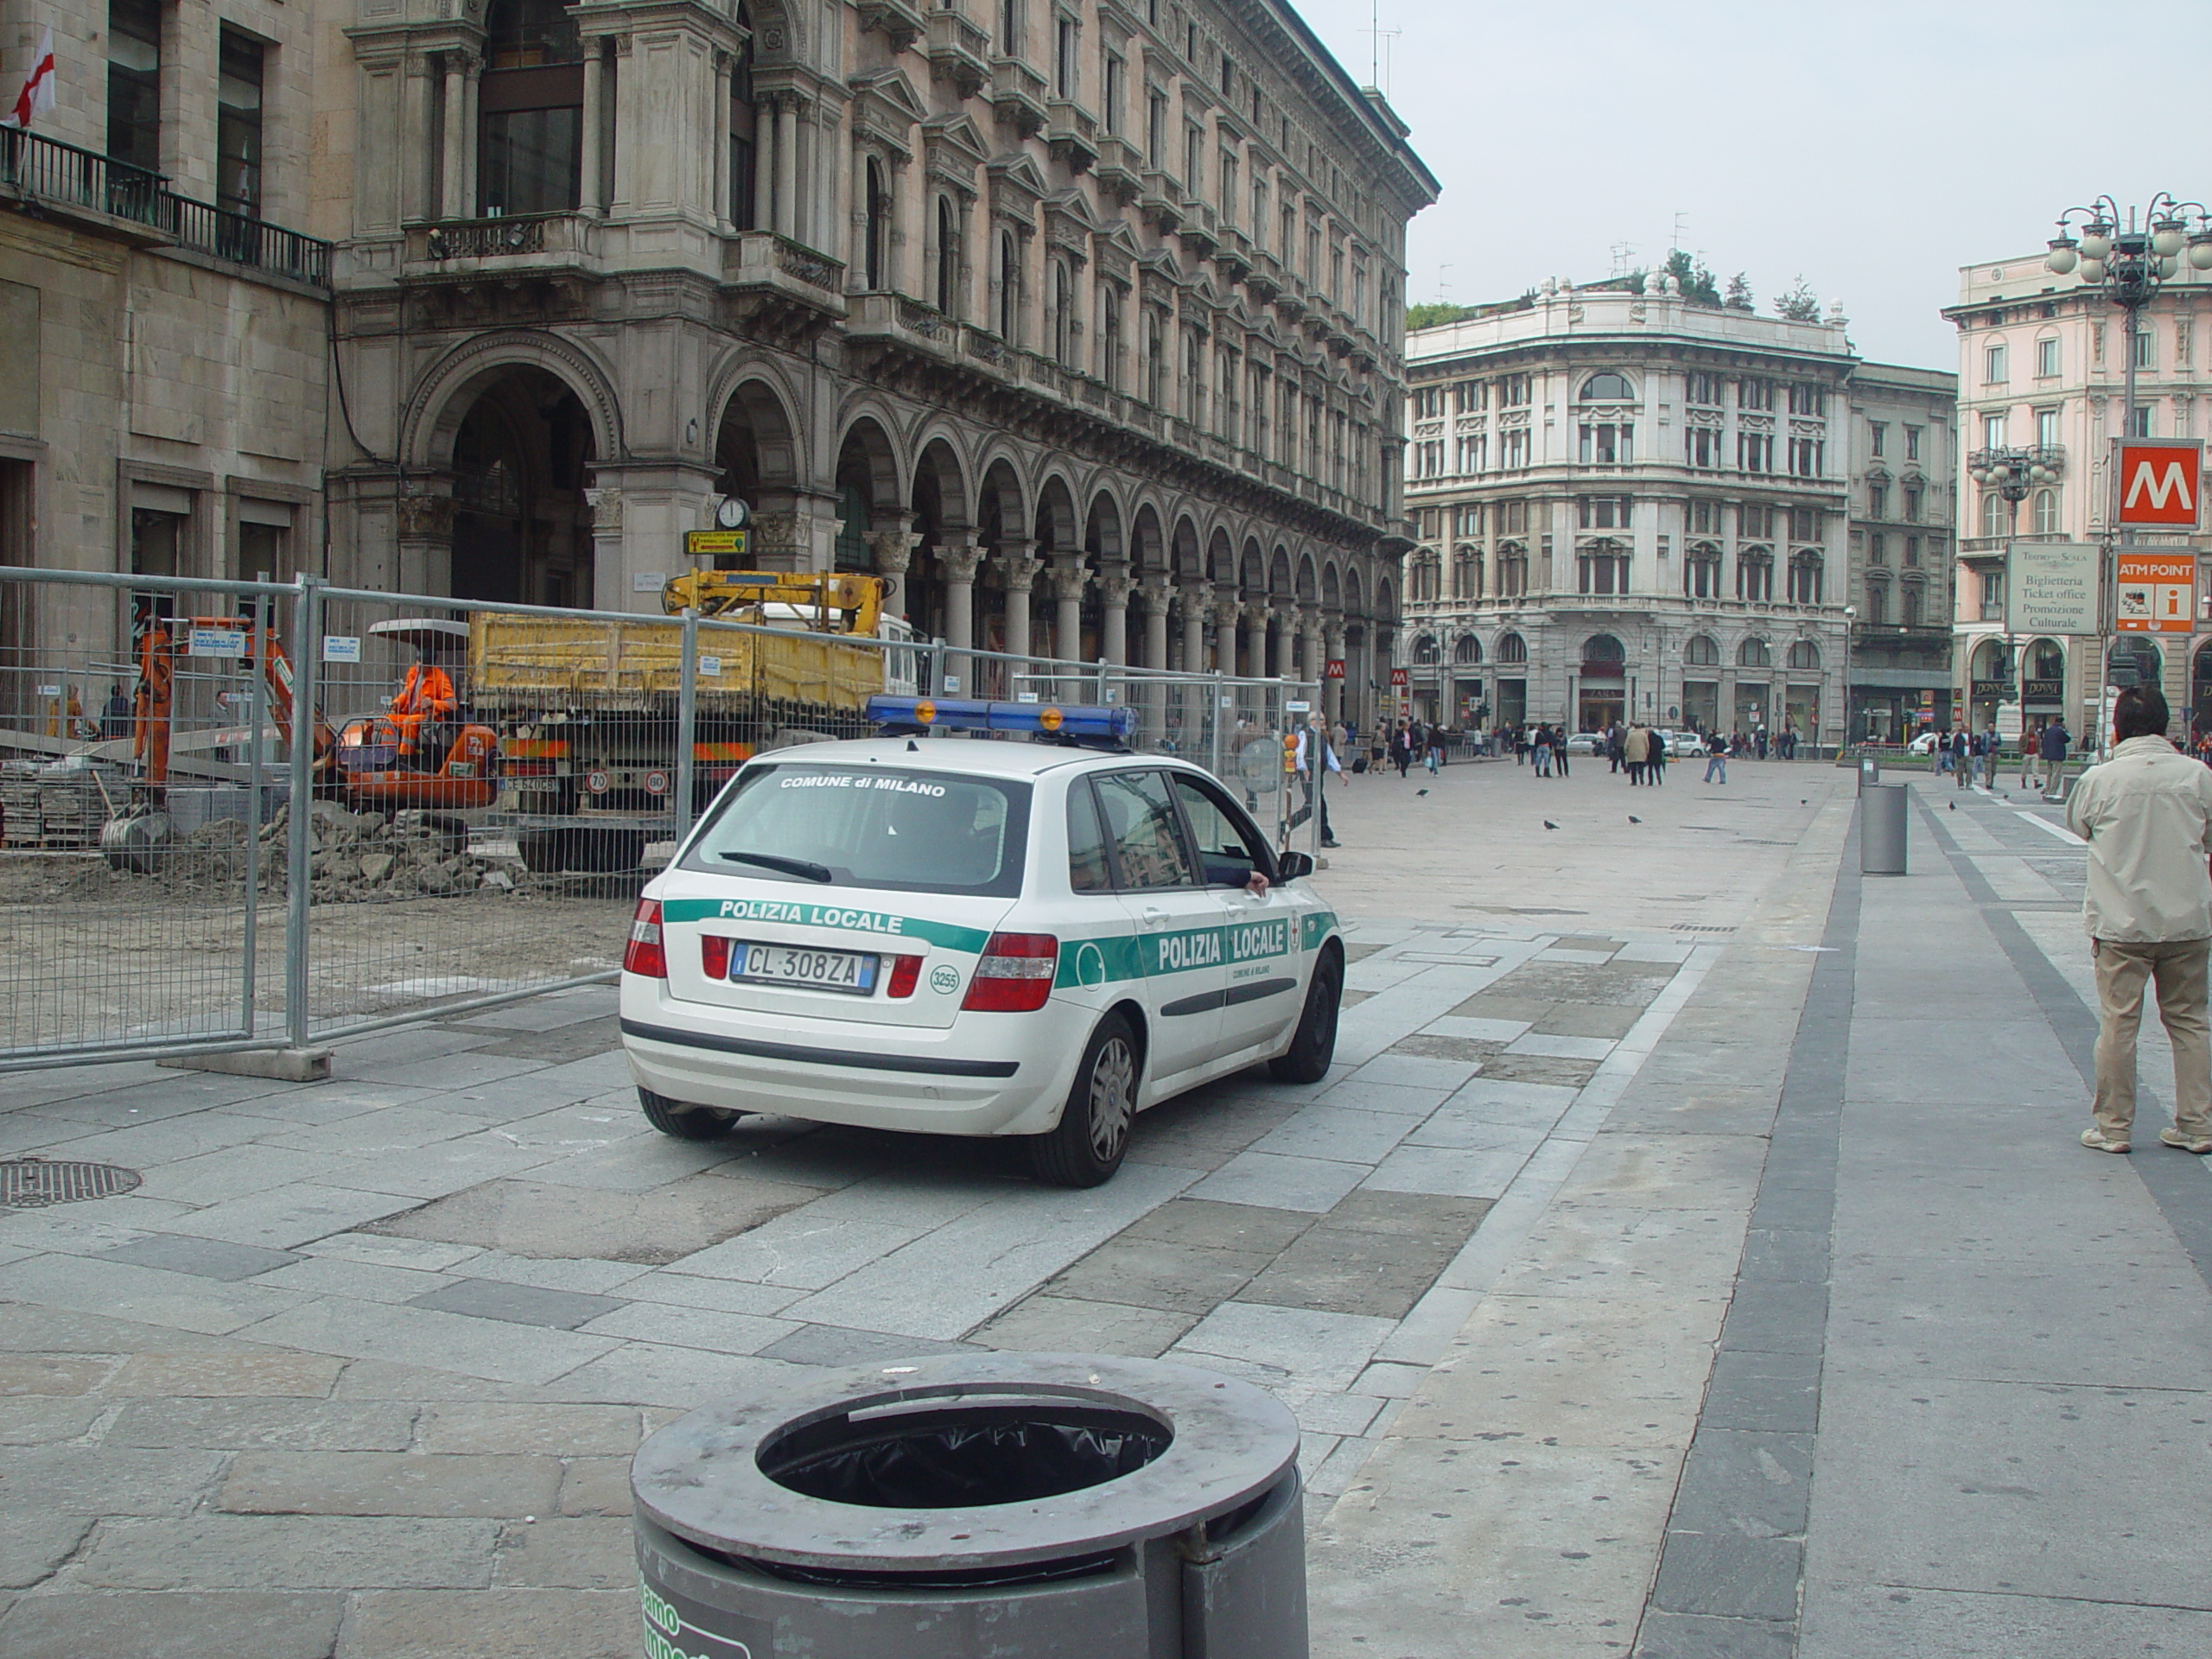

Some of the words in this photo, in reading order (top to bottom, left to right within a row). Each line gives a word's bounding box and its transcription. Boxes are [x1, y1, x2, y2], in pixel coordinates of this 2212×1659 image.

[2124, 461, 2194, 510] M
[2061, 552, 2088, 562] SCALA
[2119, 563, 2148, 575] ATM
[2150, 564, 2193, 576] POINT
[2025, 575, 2083, 588] Biglietteria
[2022, 588, 2054, 599] Ticket
[2056, 588, 2087, 600] office
[2023, 603, 2084, 614] Promozione
[2029, 617, 2077, 628] Culturale
[1328, 664, 1344, 675] M
[1392, 672, 1407, 683] M
[1976, 683, 2004, 696] DONN
[591, 775, 606, 787] 70
[649, 775, 664, 788] 80
[780, 776, 853, 788] COMUNE
[854, 777, 871, 788] di
[874, 778, 946, 798] MILANO
[719, 900, 802, 922] POLIZIA
[810, 906, 904, 933] LOCALE
[1159, 932, 1221, 970] POLIZIA
[1233, 924, 1284, 959] LOCALE
[748, 947, 774, 975] CL
[783, 950, 856, 984] 308ZA
[932, 971, 957, 988] 3255
